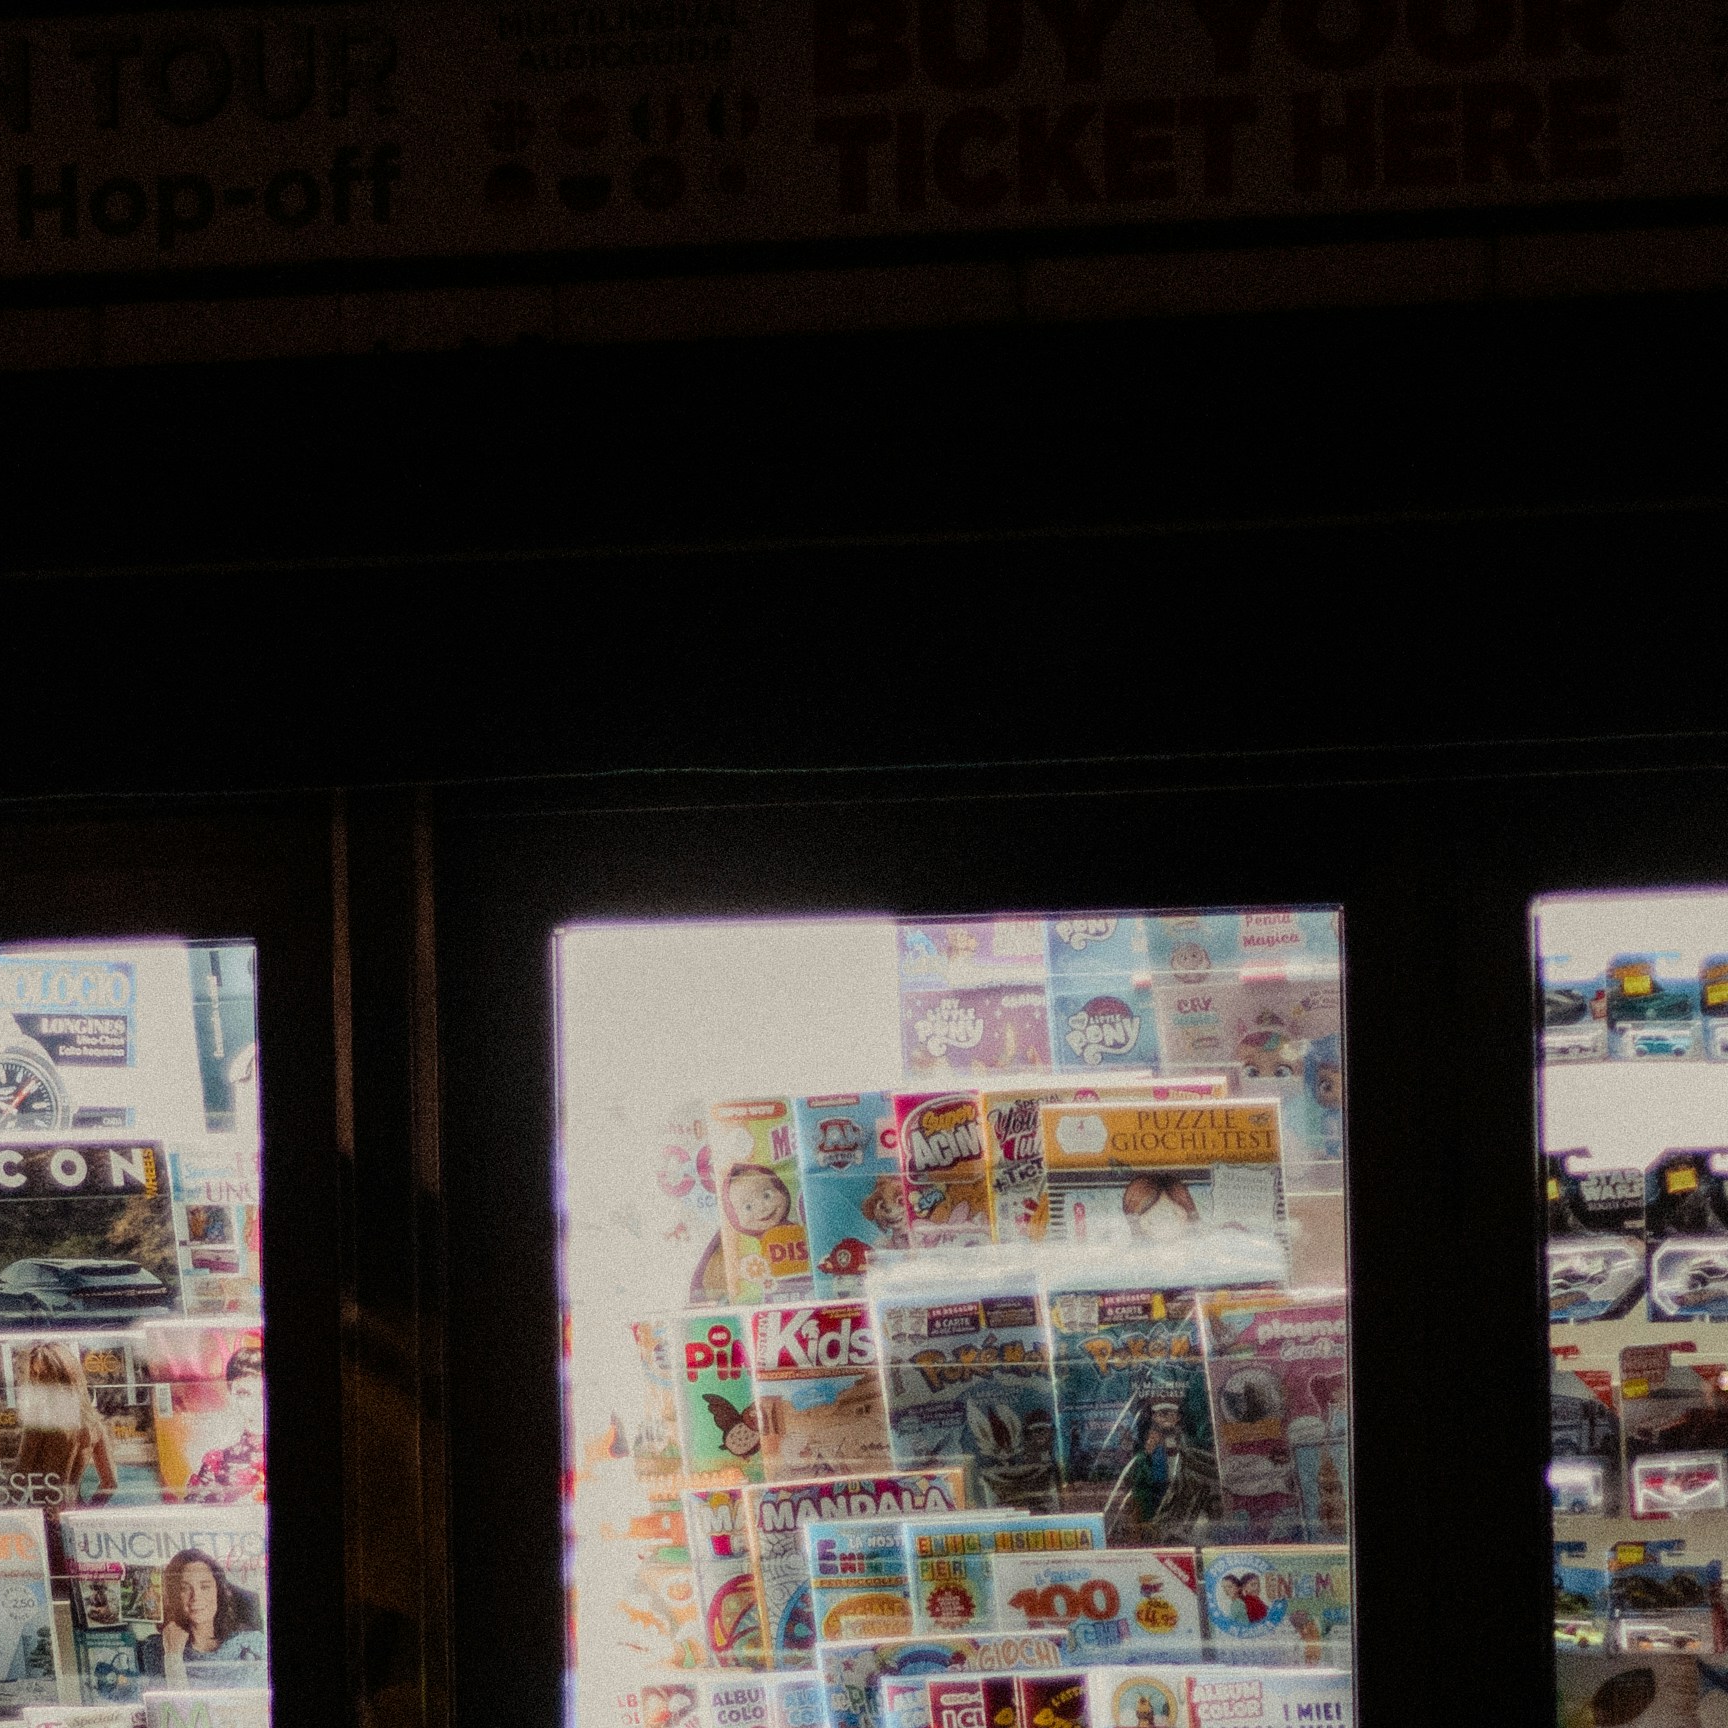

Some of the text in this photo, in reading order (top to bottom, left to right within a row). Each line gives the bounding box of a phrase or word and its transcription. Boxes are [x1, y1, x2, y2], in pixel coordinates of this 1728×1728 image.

[75, 20, 400, 132] TOUR
[812, 0, 1628, 97] BUY YOUR
[813, 95, 1259, 214] TICKET
[1289, 76, 1625, 194] HERE
[16, 145, 401, 249] Hop-off
[1138, 1109, 1238, 1130] PUZZLE
[767, 1310, 876, 1370] Kids
[762, 1489, 954, 1534] MANDALA
[1297, 1702, 1343, 1721] MIEI
